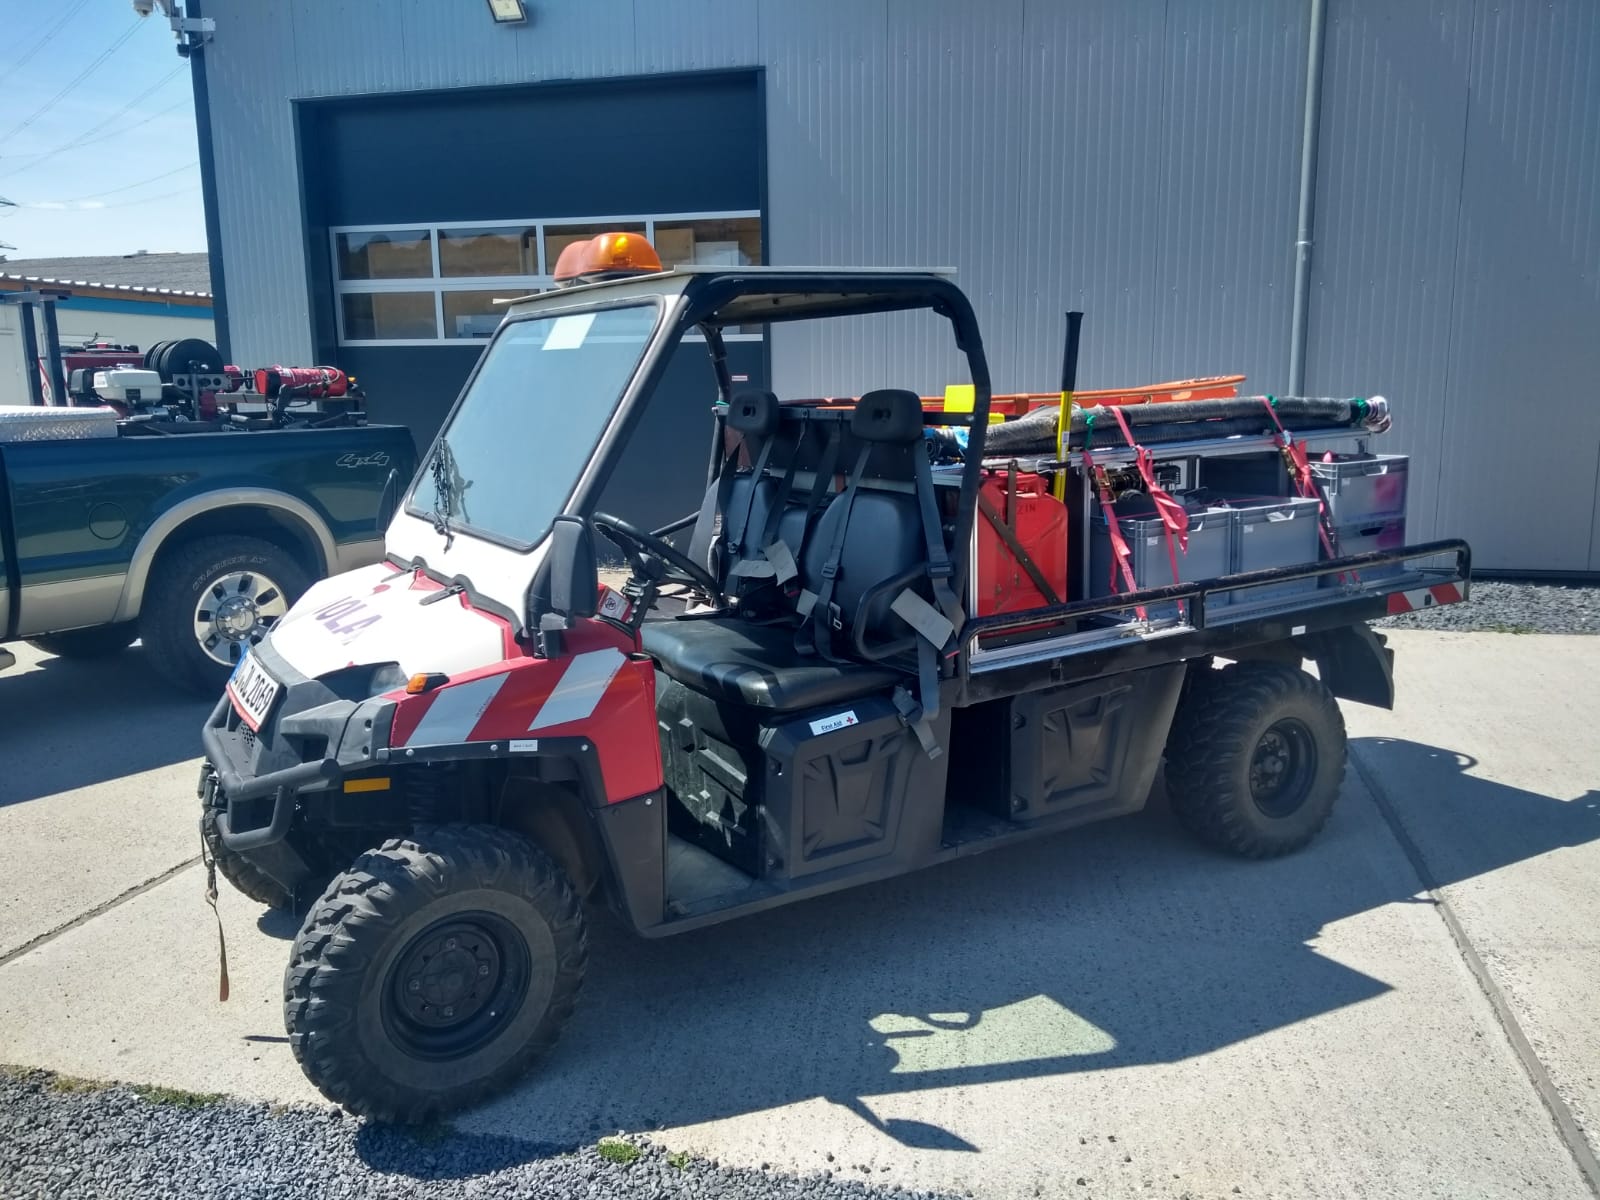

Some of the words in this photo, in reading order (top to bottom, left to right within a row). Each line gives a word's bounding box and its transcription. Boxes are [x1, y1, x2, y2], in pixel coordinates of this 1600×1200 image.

[336, 452, 390, 468] 4x4
[246, 674, 275, 716] 2069
[821, 723, 834, 731] First
[833, 720, 843, 728] Aid
